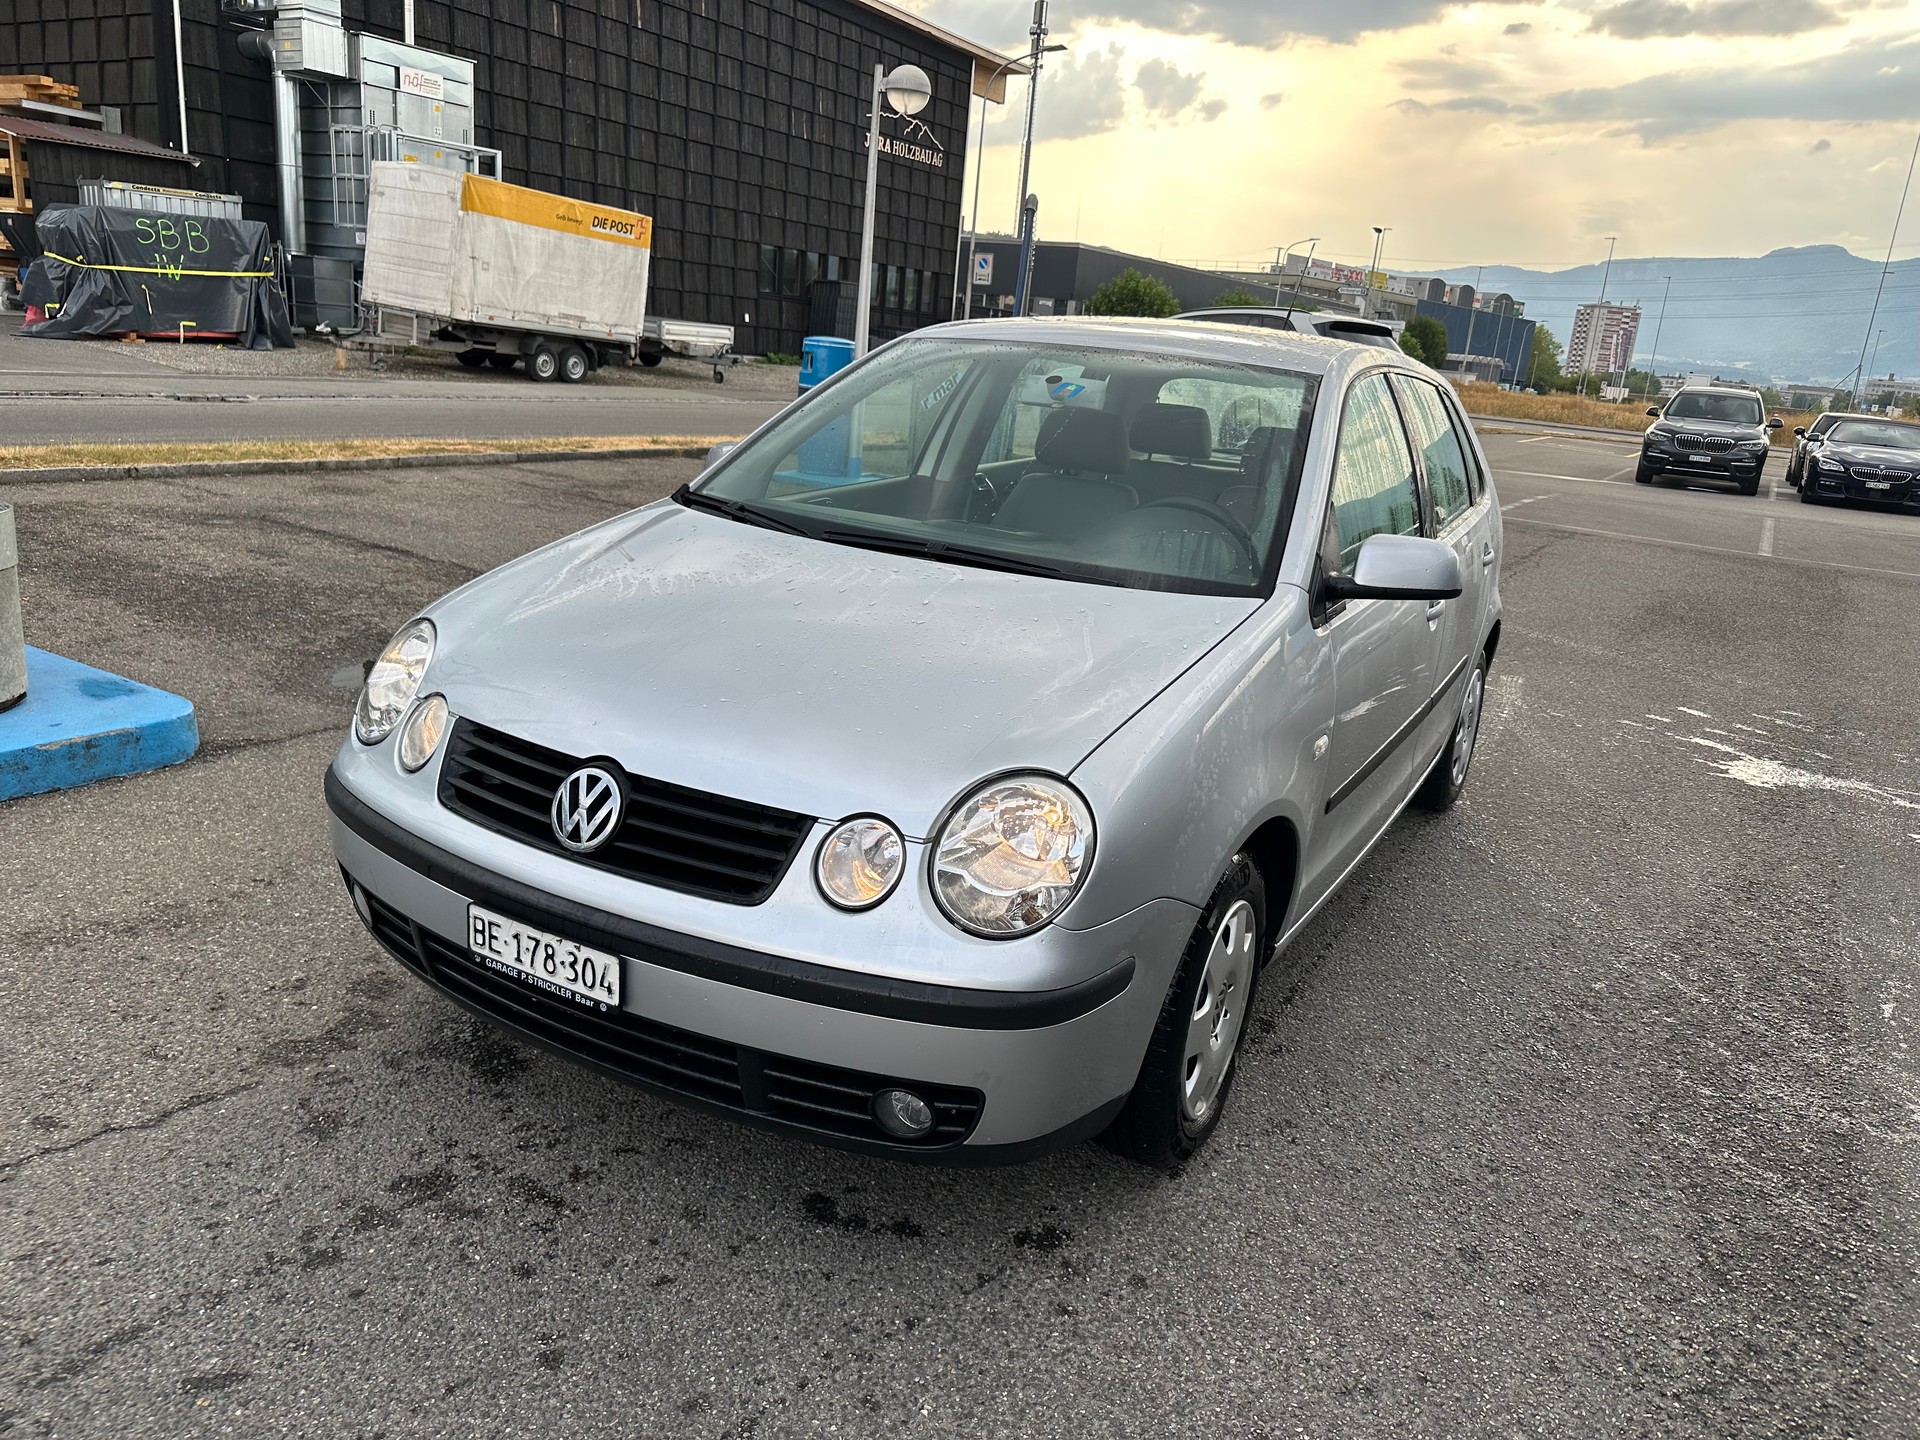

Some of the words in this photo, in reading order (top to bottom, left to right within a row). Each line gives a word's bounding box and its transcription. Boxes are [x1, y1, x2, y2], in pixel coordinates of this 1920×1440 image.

[864, 133, 891, 153] JRA
[892, 141, 932, 164] HOLZBAU
[931, 152, 943, 167] AG
[131, 184, 160, 192] Condecta
[135, 218, 210, 253] SBB
[555, 213, 567, 222] Gelb
[592, 216, 609, 230] DIE
[609, 220, 635, 235] POST
[485, 958, 519, 978] GARAGE
[575, 993, 595, 1008] Baar
